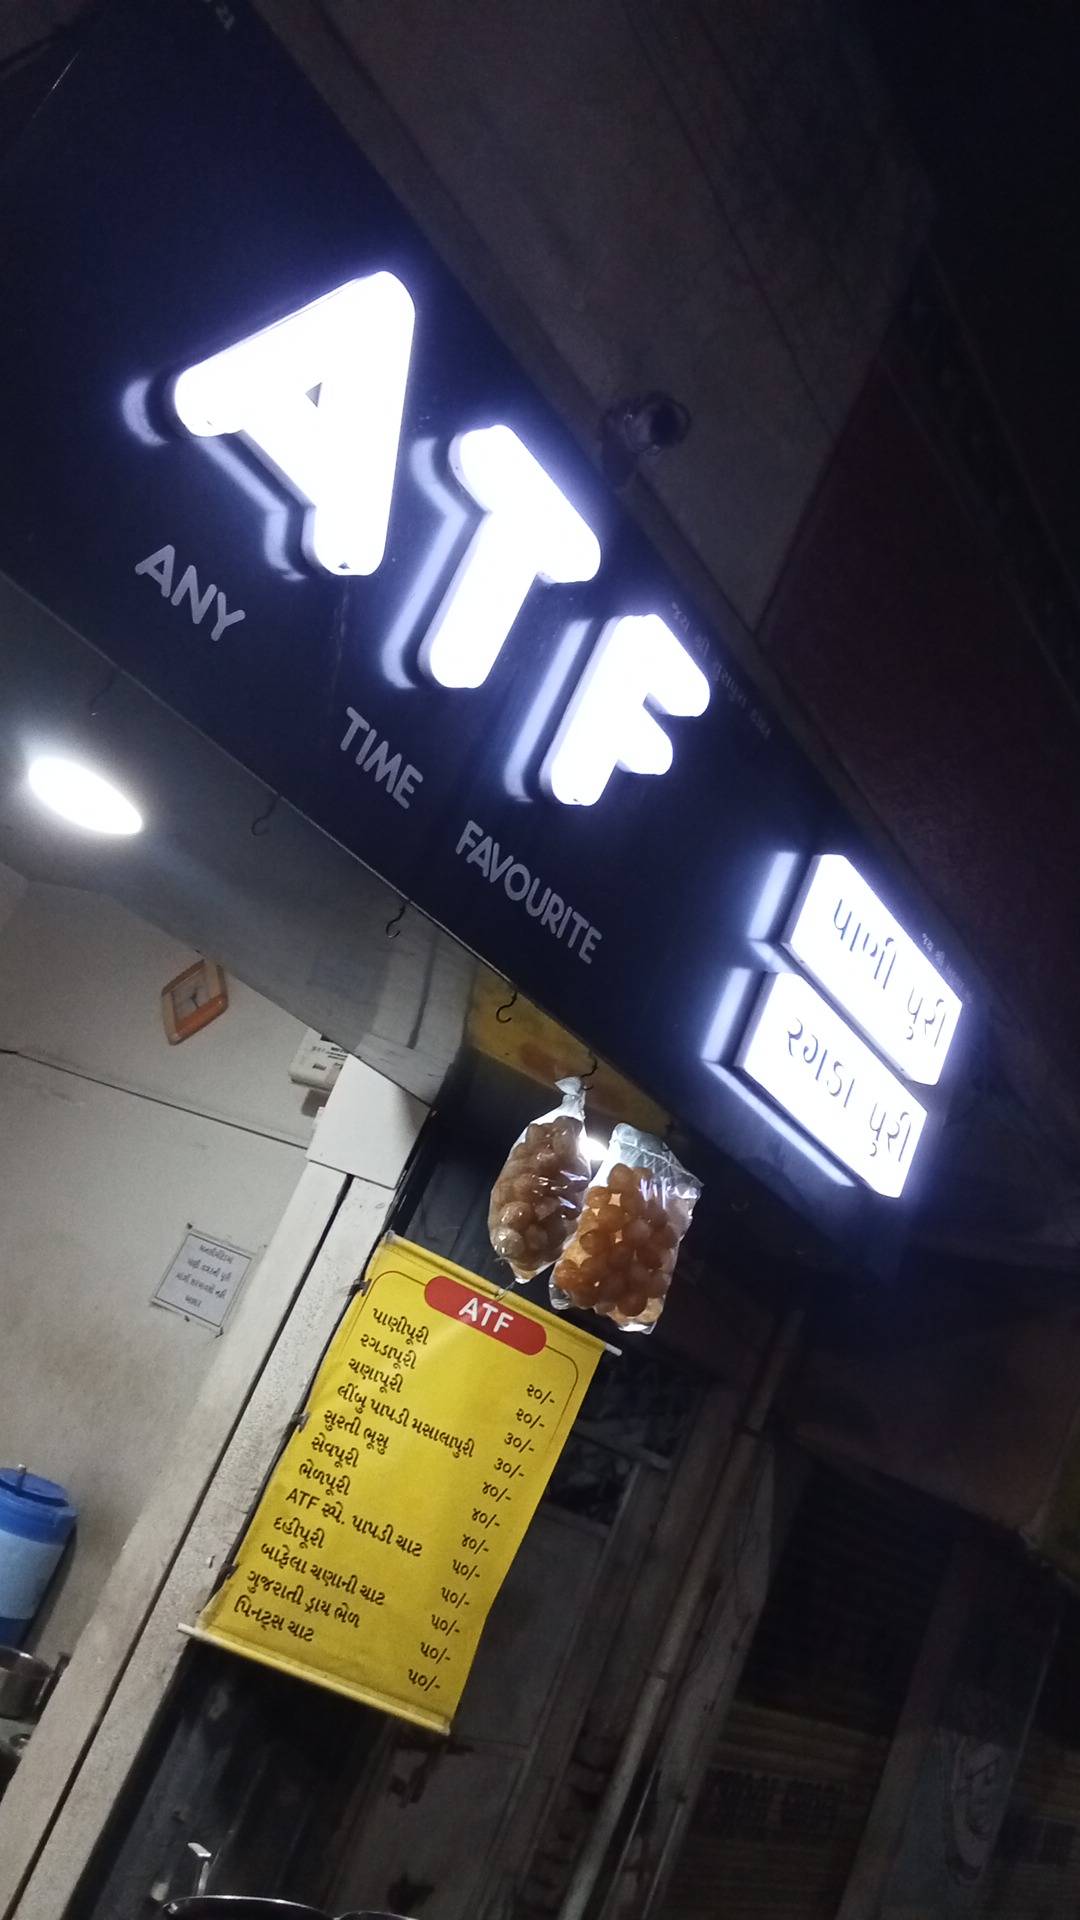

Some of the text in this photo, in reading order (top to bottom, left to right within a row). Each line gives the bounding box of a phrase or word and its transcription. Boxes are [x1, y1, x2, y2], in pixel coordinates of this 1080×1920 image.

[174, 270, 711, 806] ATF
[134, 544, 602, 964] ANY TIME FAVOURITE
[833, 898, 946, 1049] પાણી પૂરી
[788, 1017, 912, 1163] રગડા પૂરી
[372, 1308, 429, 1346] પાણીપૂરી
[458, 1297, 514, 1333] ATF
[360, 1334, 417, 1370] રગડાપૂરી
[347, 1357, 403, 1394] ચણાપૂરી
[324, 1410, 361, 1436] સુરતી
[370, 1398, 409, 1428] પાપડી
[311, 1432, 360, 1468] સેવપૂરી
[299, 1459, 351, 1496] ભેળપૂરી
[273, 1517, 325, 1549] દહીપૂરી
[285, 1488, 321, 1510] ATF
[352, 1514, 394, 1545] પાપડી
[395, 1535, 423, 1557] ચાટ
[247, 1570, 304, 1605] ગુજરાતી
[305, 1596, 331, 1617] ડ્રાય
[334, 1602, 361, 1628] ભેળ
[310, 1564, 358, 1595] ચણાની
[359, 1585, 386, 1606] ચાટ
[287, 1620, 315, 1642] ચાટ
